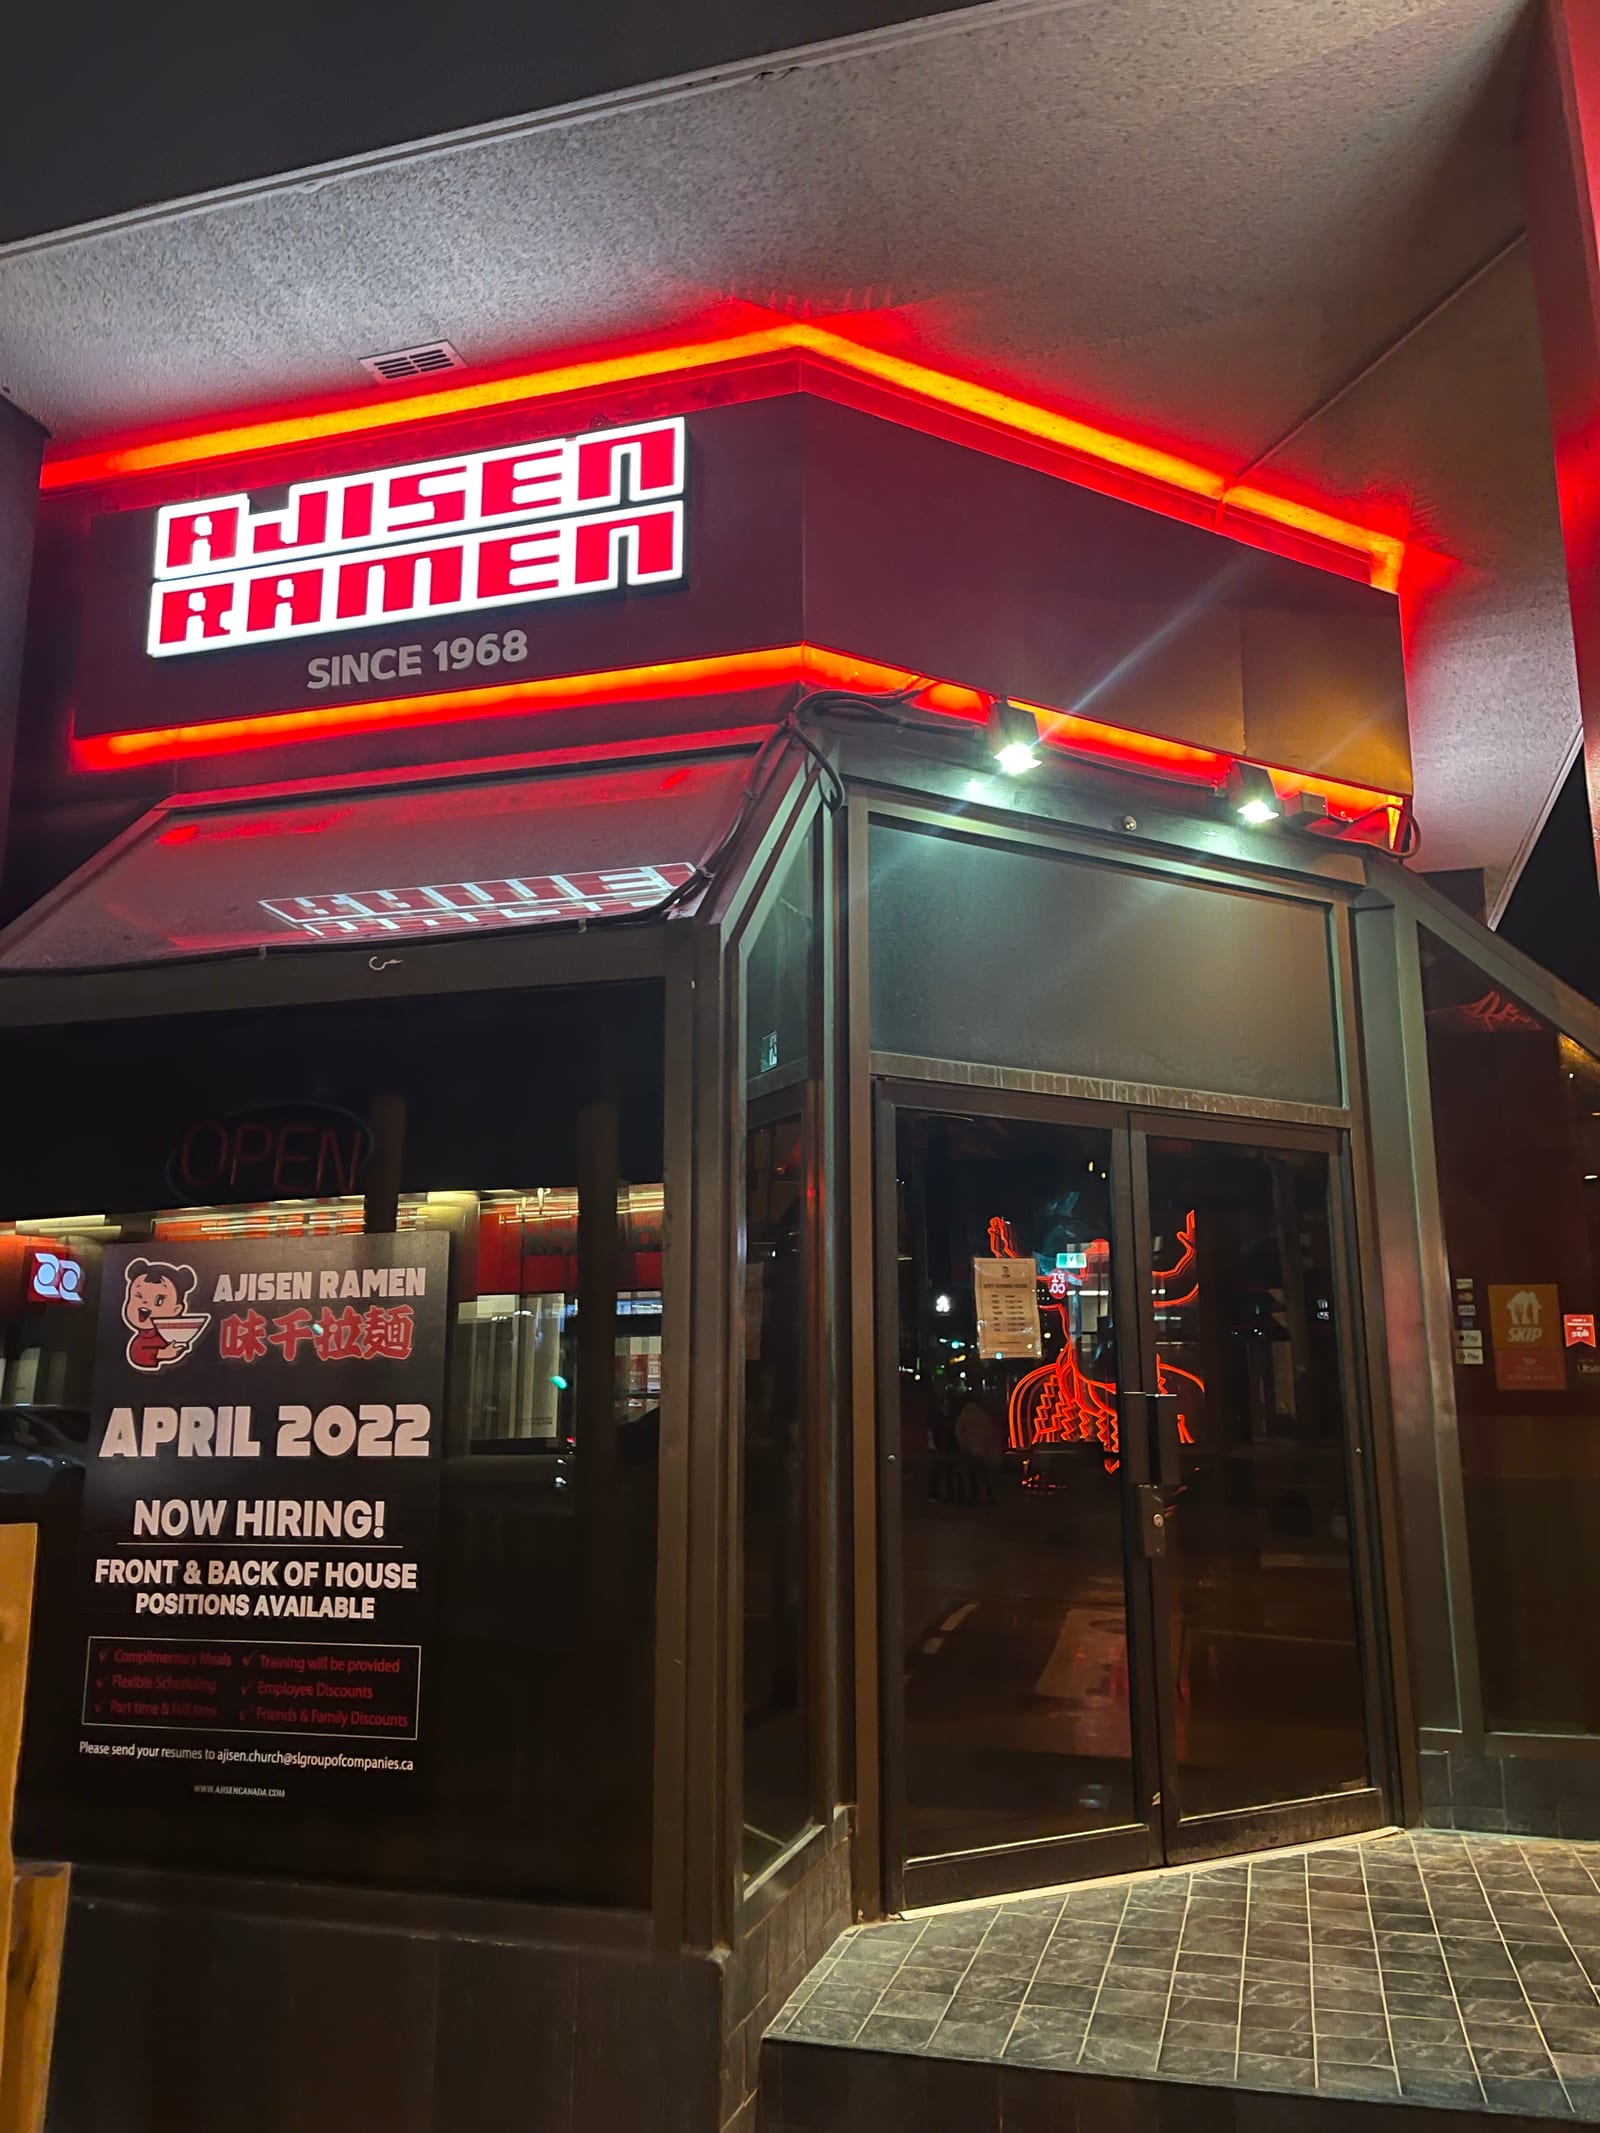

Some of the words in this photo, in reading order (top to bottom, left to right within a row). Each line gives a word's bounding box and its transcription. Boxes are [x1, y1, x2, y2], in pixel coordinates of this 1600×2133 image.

[157, 420, 683, 575] AJISEN
[149, 503, 683, 654] RAMEN
[306, 642, 422, 690] SINCE
[431, 628, 529, 674] 1968
[180, 1119, 362, 1194] OPEN
[213, 1272, 312, 1302] AJISEN
[319, 1268, 426, 1298] RAMEN
[1507, 1327, 1543, 1342] SKIP
[98, 1405, 260, 1458] APRIL
[276, 1404, 431, 1457] 2022
[133, 1499, 227, 1537] NOW
[236, 1500, 385, 1538] HIRING!
[95, 1559, 178, 1584] FRONT
[183, 1561, 200, 1585] &
[207, 1560, 279, 1586] BACK
[284, 1562, 319, 1587] OF
[325, 1562, 417, 1589] HOUSE
[135, 1593, 249, 1616] POSITIONS
[253, 1595, 375, 1619] AVAILABLE
[260, 1653, 305, 1673] Training
[308, 1656, 328, 1671] will
[330, 1656, 345, 1671] be
[347, 1658, 400, 1674] provided
[112, 1674, 153, 1689] Flexible
[258, 1681, 313, 1698] Employee
[316, 1682, 373, 1699] Discounts
[256, 1706, 297, 1723] Friends
[299, 1708, 309, 1723] &
[311, 1709, 350, 1728] Family
[351, 1711, 408, 1728] Discounts
[79, 1741, 110, 1755] Please
[111, 1743, 135, 1757] send
[136, 1746, 159, 1760] your
[162, 1748, 203, 1760] resumes
[204, 1747, 216, 1761] to
[217, 1749, 414, 1771] ajisen.church@slgroupofcompanies.ca
